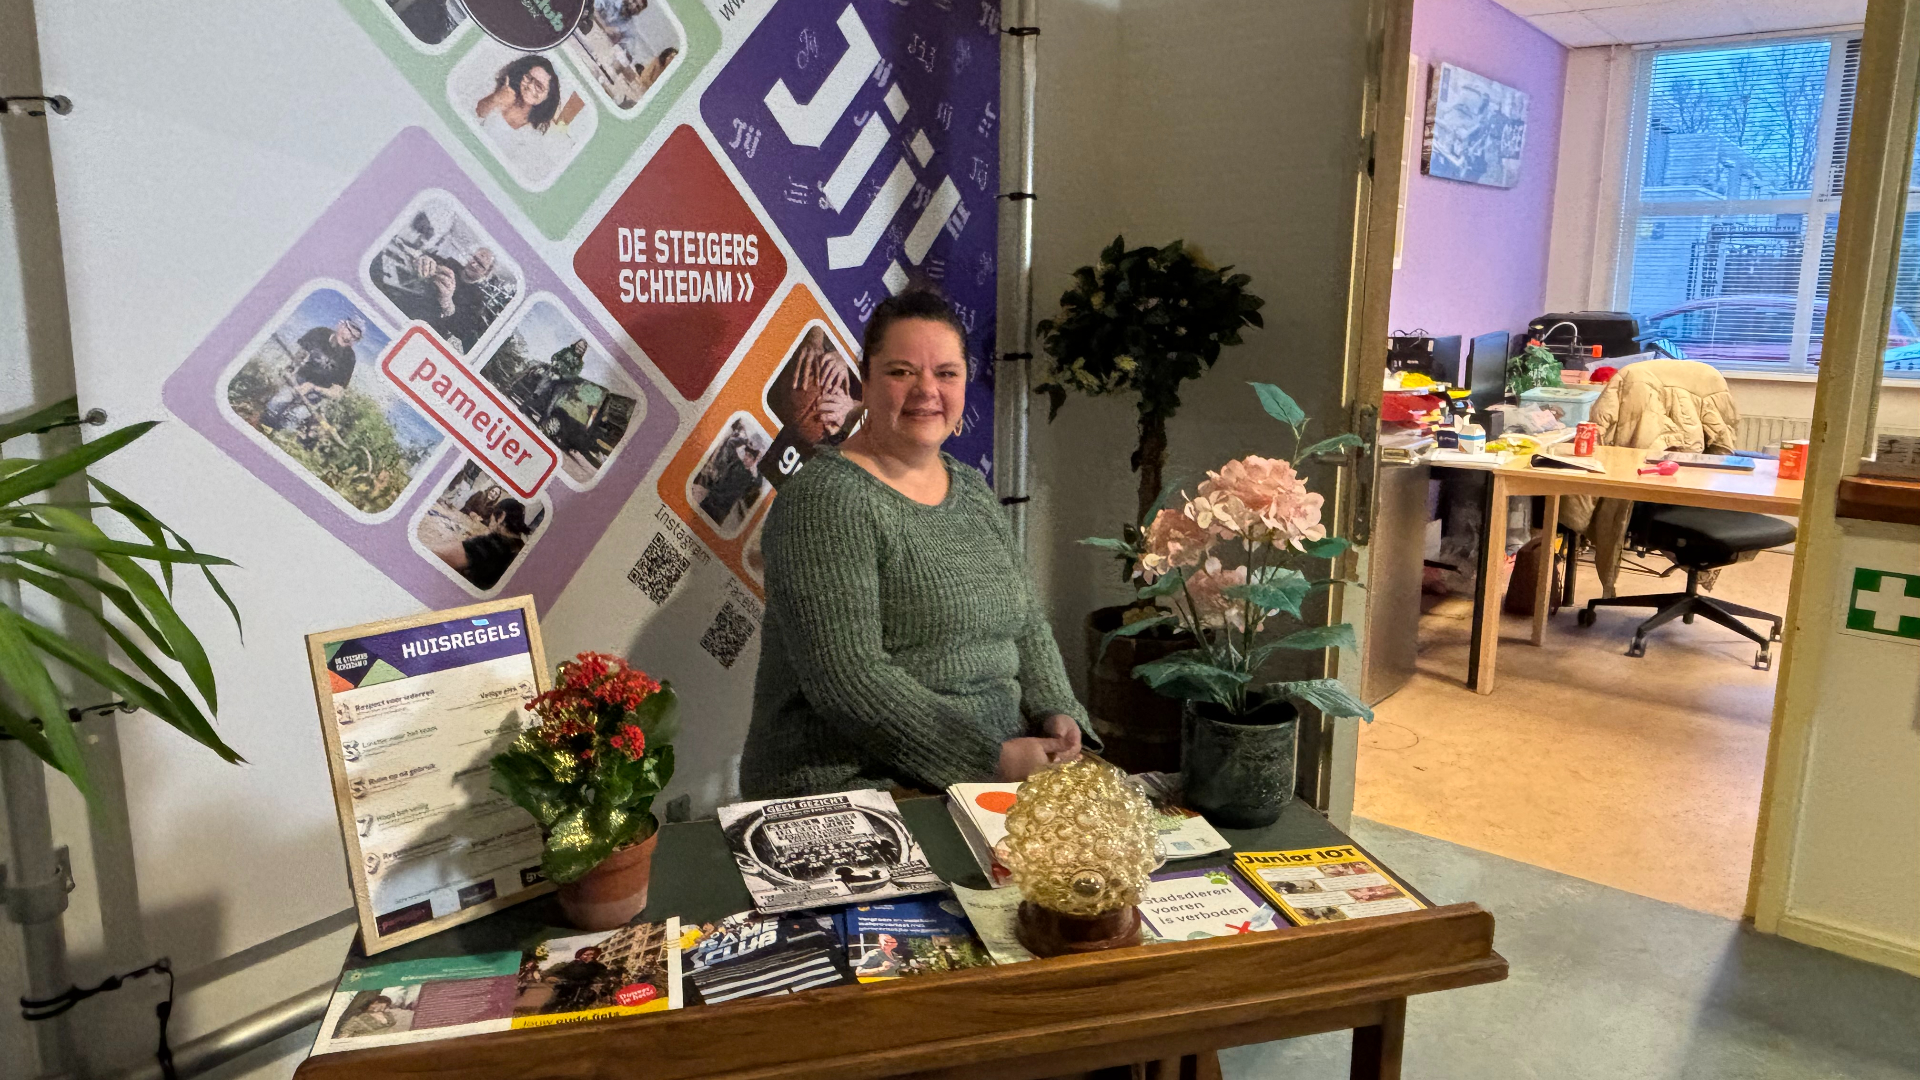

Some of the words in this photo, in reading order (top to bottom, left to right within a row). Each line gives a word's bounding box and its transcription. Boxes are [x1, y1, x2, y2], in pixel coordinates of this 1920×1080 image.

[618, 227, 647, 263] DE
[655, 229, 759, 266] STEIGERS
[619, 270, 734, 304] SCHIEDAM
[409, 357, 533, 467] pameijer
[654, 503, 711, 567] Instagram
[401, 621, 522, 660] HUISREGELS
[765, 802, 797, 814] GEEN
[798, 796, 846, 810] GEZICHT
[1239, 852, 1313, 865] Junior
[1315, 848, 1358, 860] IOT
[1145, 887, 1232, 905] Stadsdieren
[1150, 901, 1206, 916] voeren
[1158, 916, 1175, 926] is
[1175, 906, 1250, 923] verboden
[704, 930, 778, 966] CLUB
